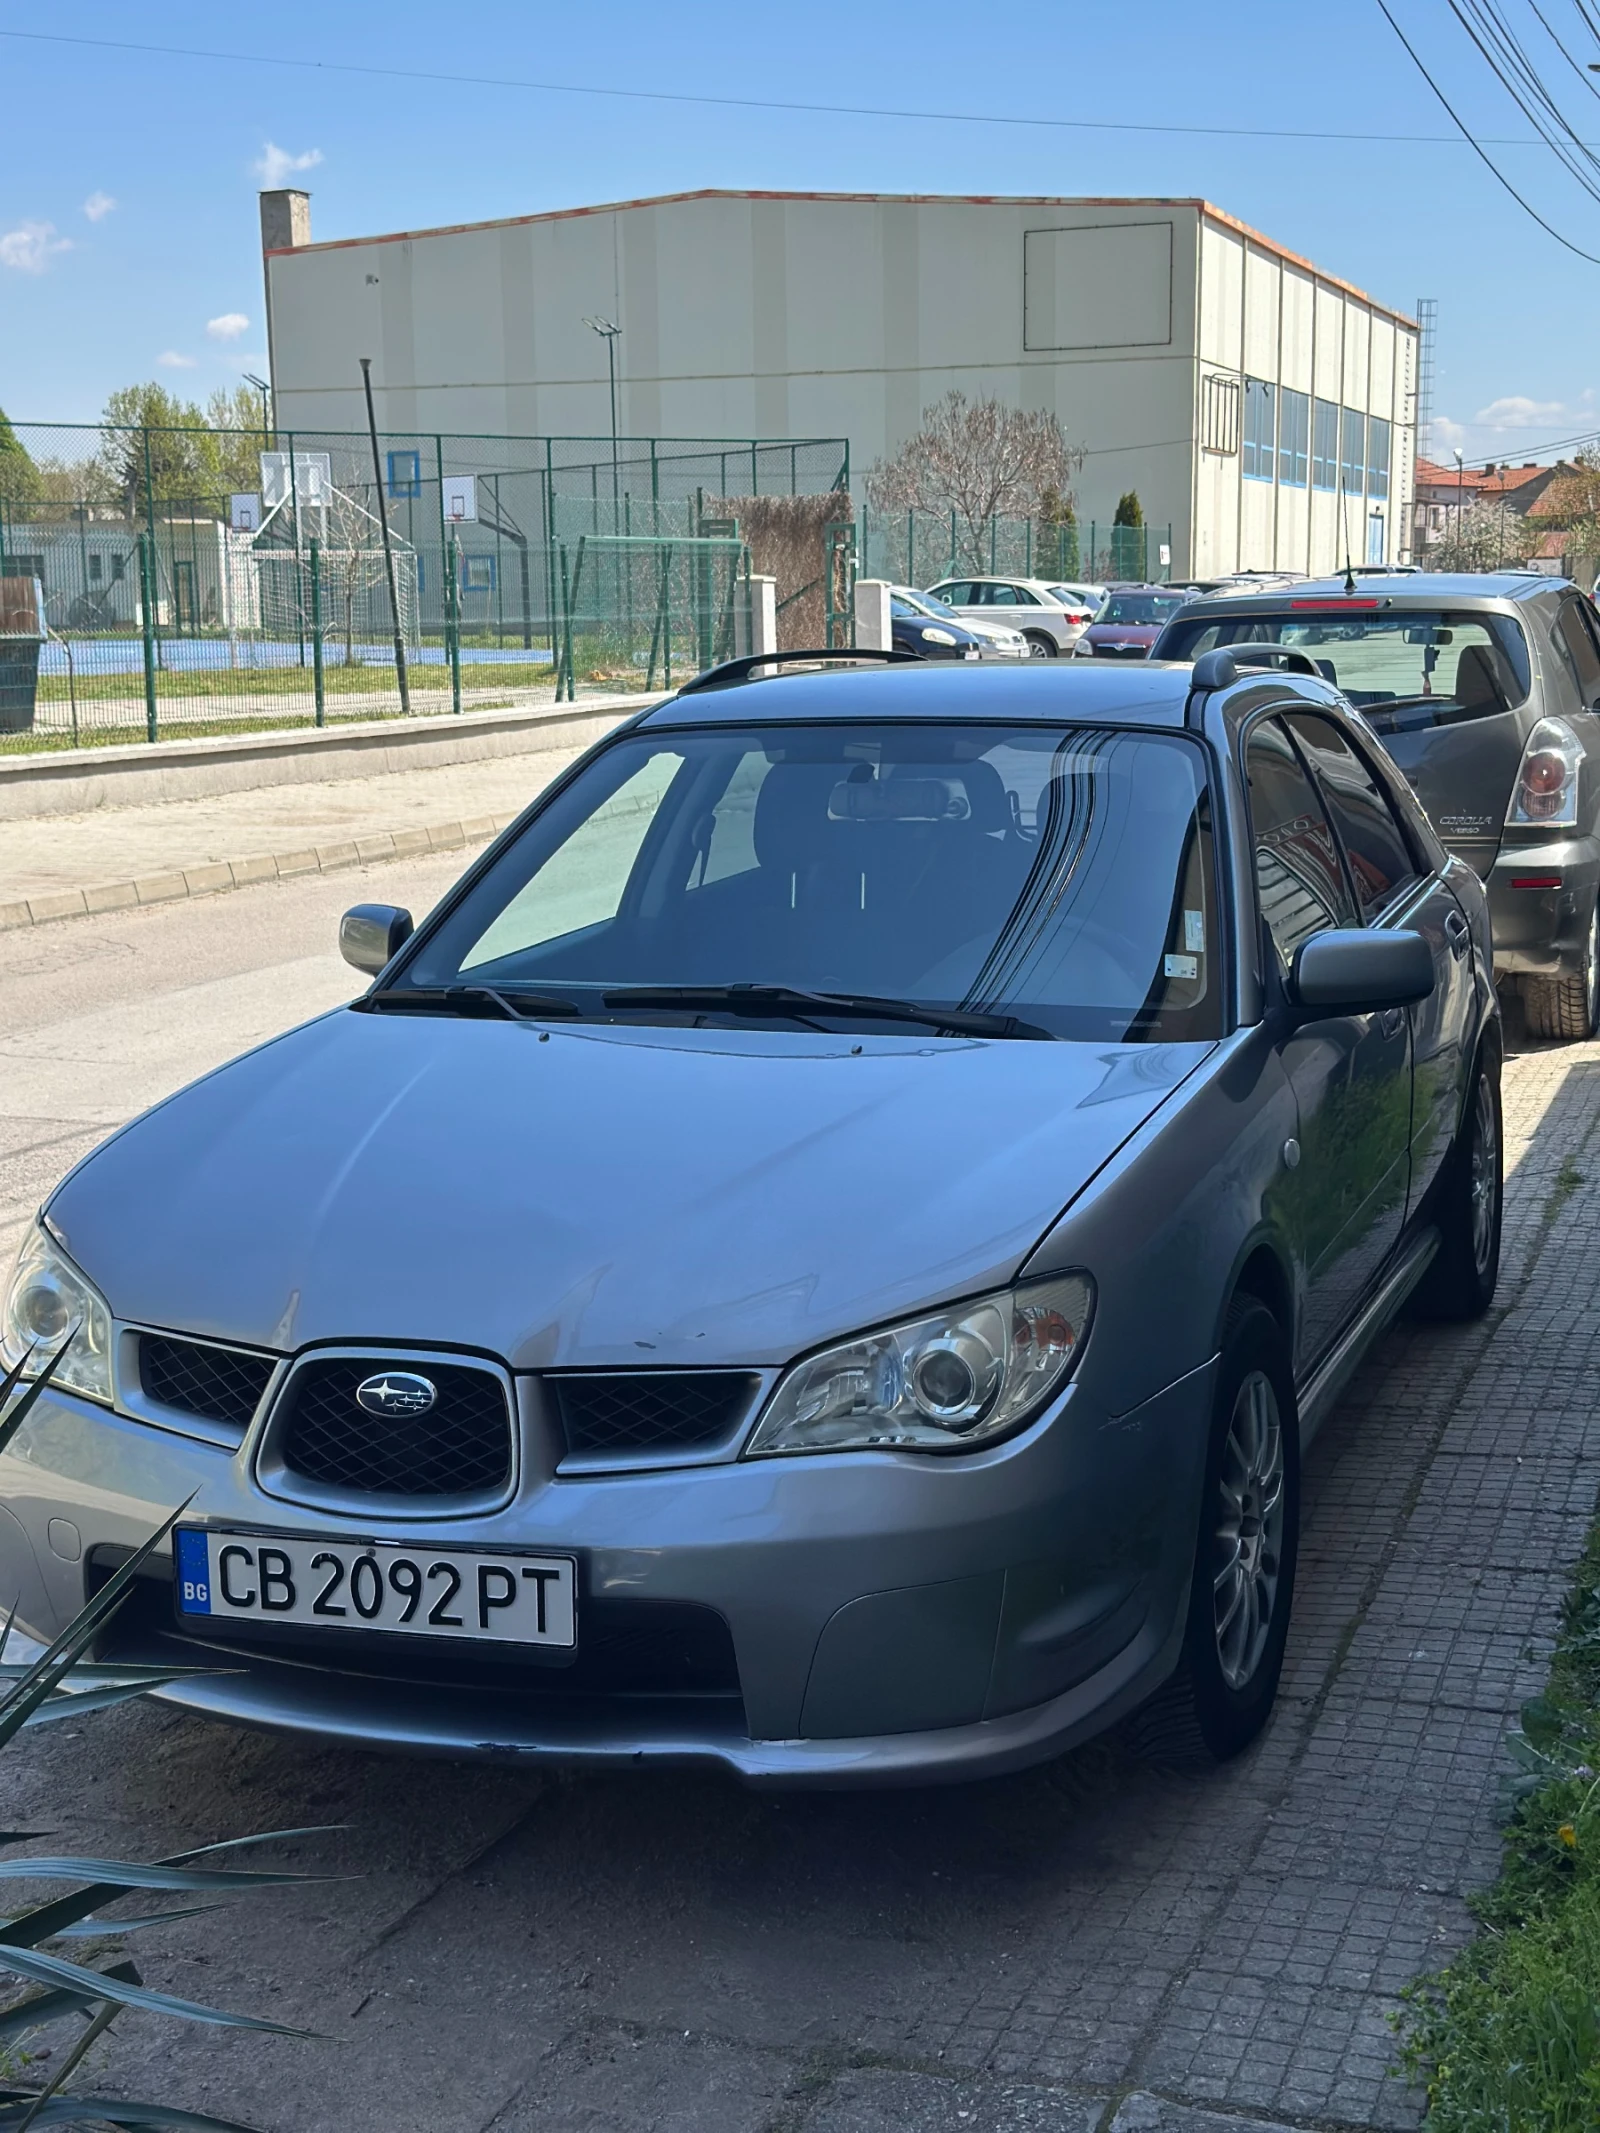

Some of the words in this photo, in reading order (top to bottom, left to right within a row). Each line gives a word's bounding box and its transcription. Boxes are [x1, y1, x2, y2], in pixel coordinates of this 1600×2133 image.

[1440, 816, 1492, 825] COROLLA
[183, 1581, 208, 1601] BG
[218, 1544, 297, 1611] CB
[310, 1552, 464, 1627] 2092
[477, 1564, 560, 1634] PT
